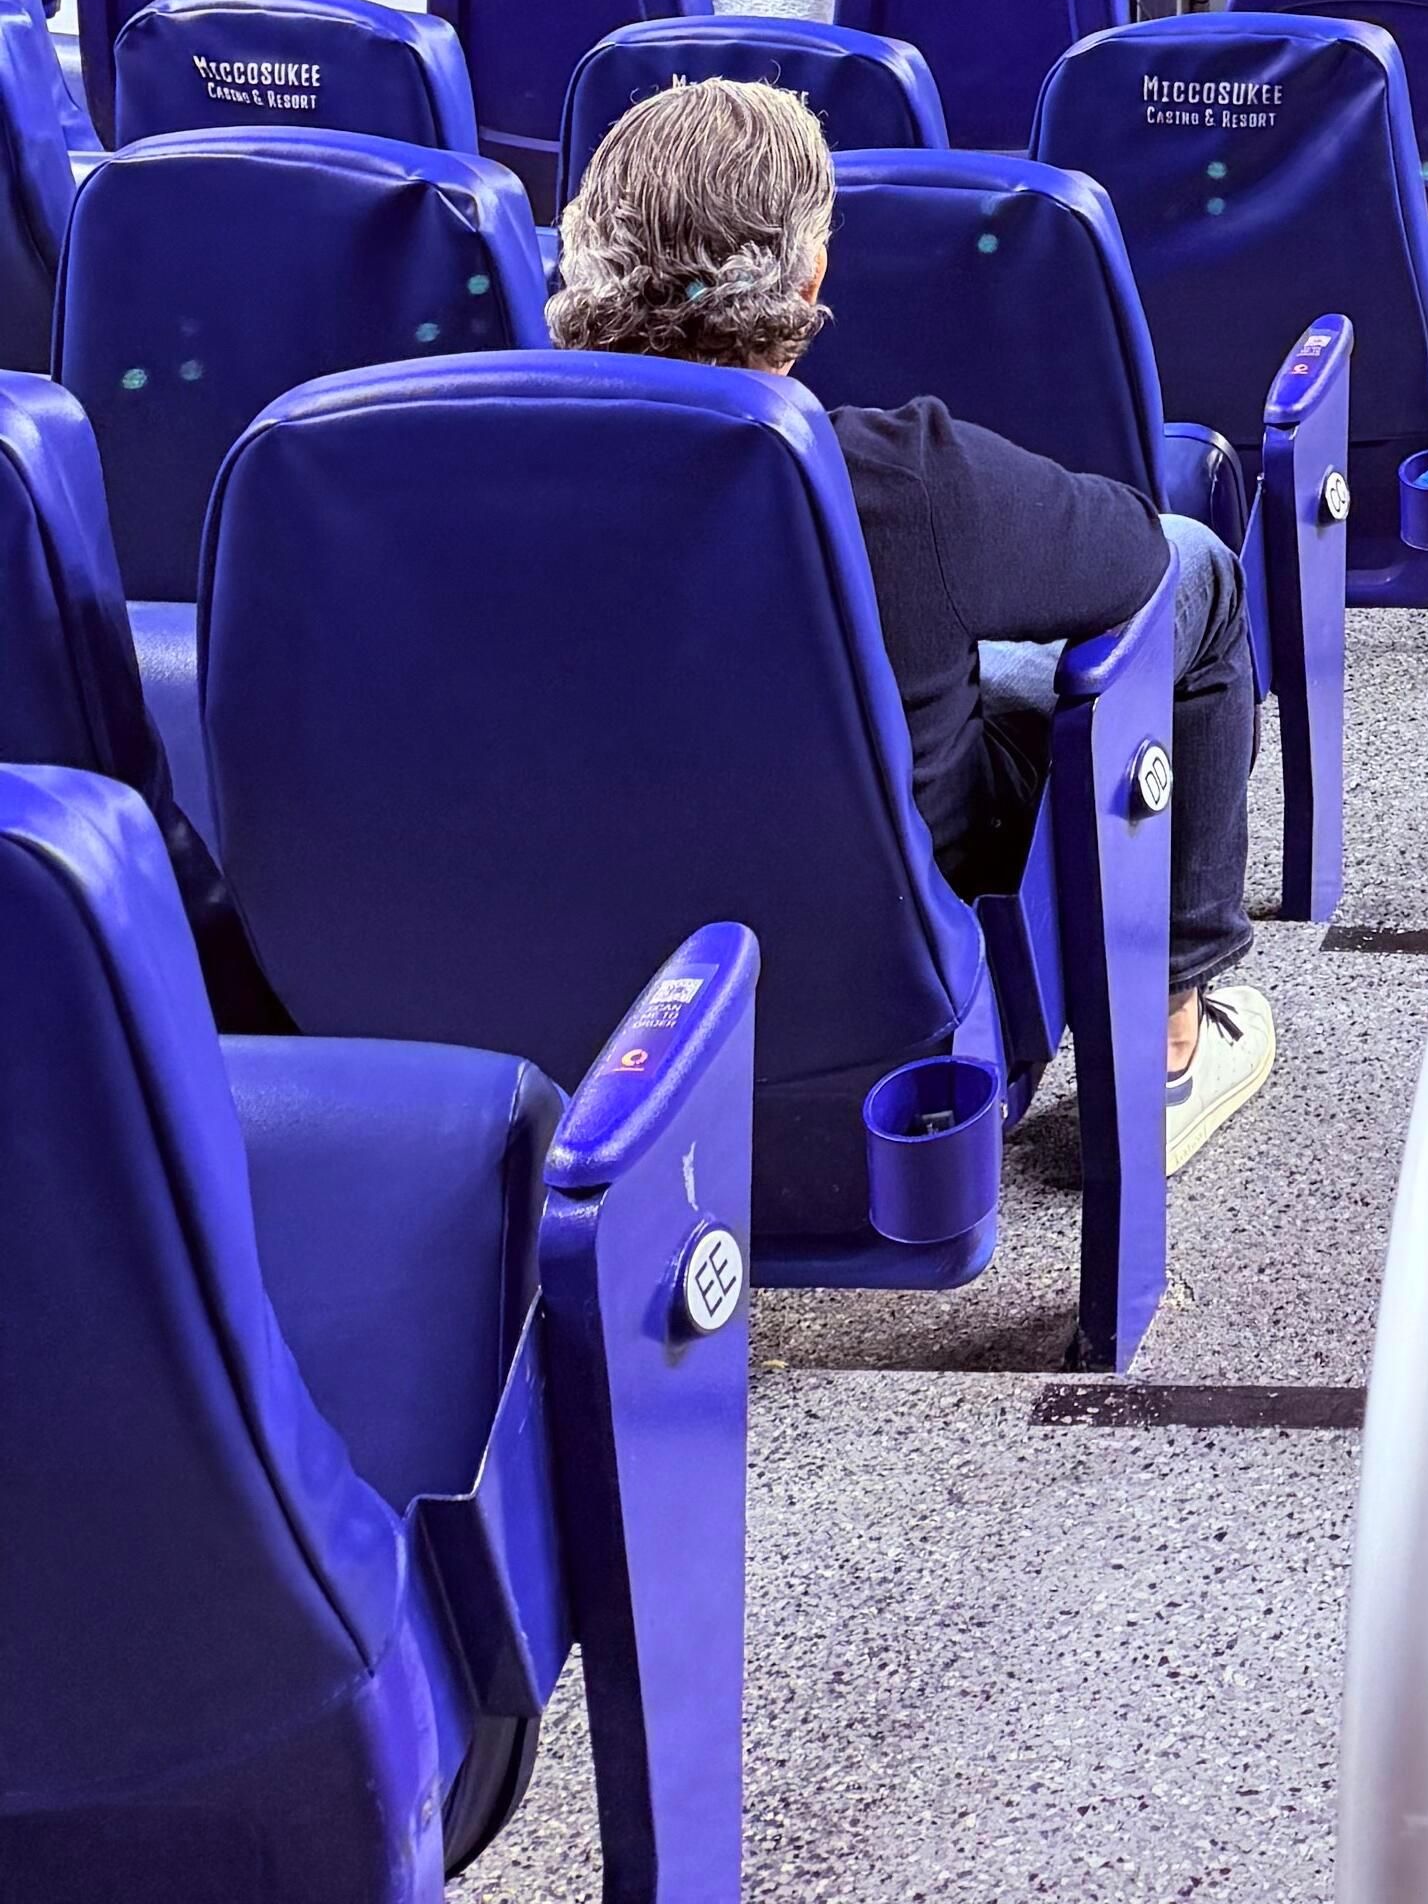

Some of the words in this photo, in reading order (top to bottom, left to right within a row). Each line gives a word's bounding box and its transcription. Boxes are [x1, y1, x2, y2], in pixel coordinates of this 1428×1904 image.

[1204, 108, 1216, 127] &
[1144, 756, 1168, 805] DD
[694, 1240, 737, 1318] EE
